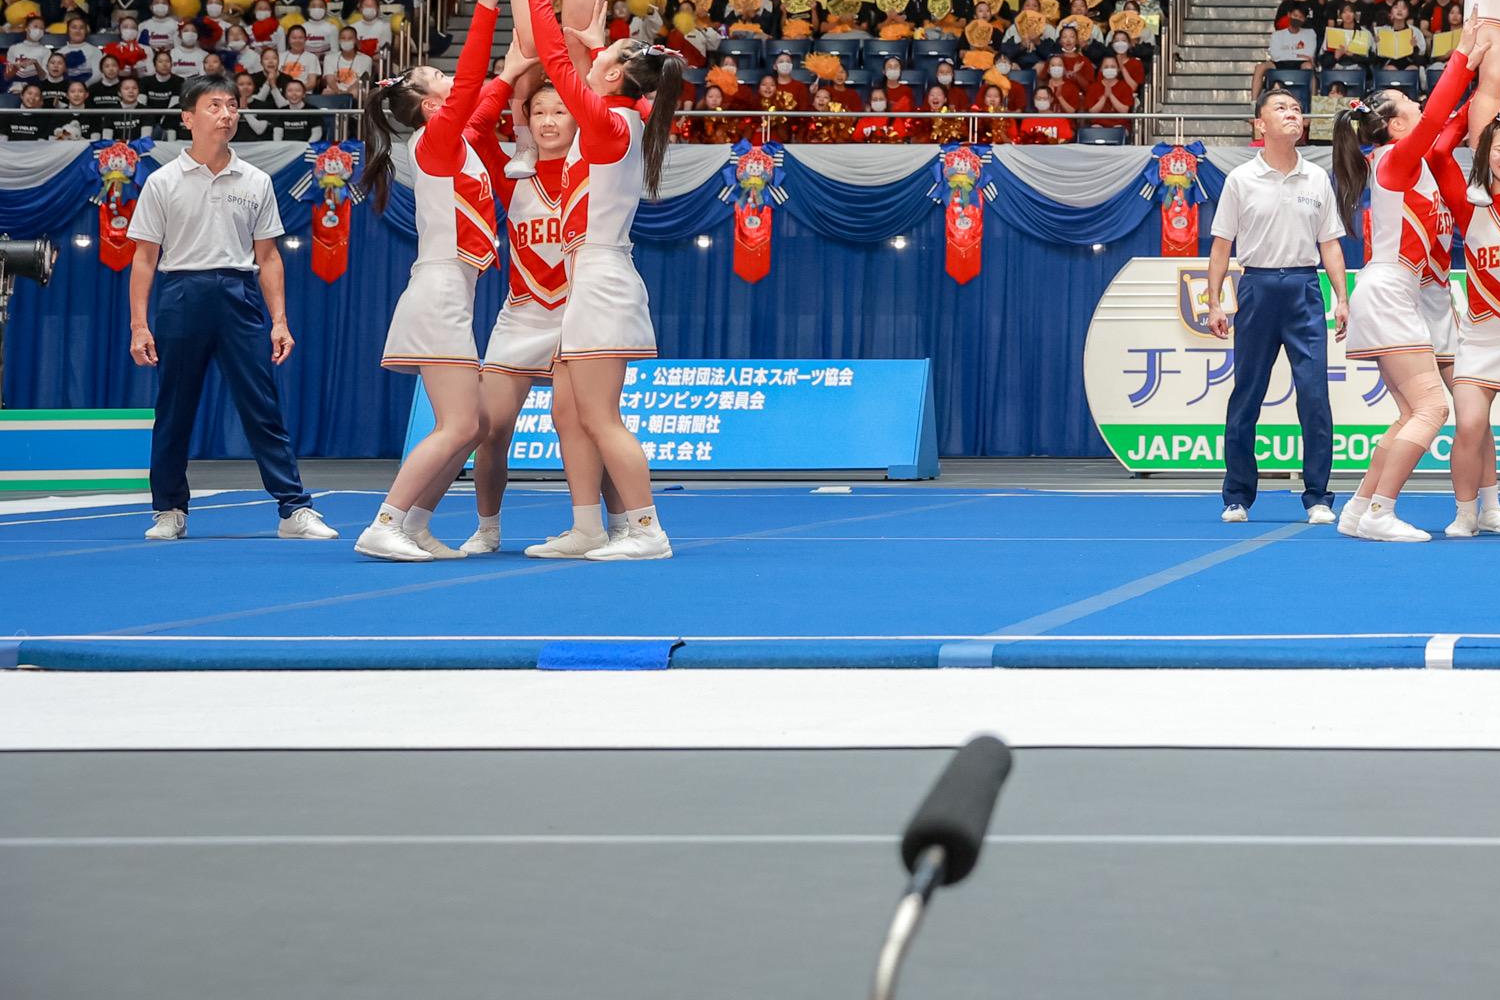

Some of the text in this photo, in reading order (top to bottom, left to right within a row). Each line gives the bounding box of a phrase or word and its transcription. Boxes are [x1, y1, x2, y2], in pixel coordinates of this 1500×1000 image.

[227, 194, 259, 210] SPOTTER
[517, 217, 562, 250] BEA
[1254, 434, 1304, 461] CU
